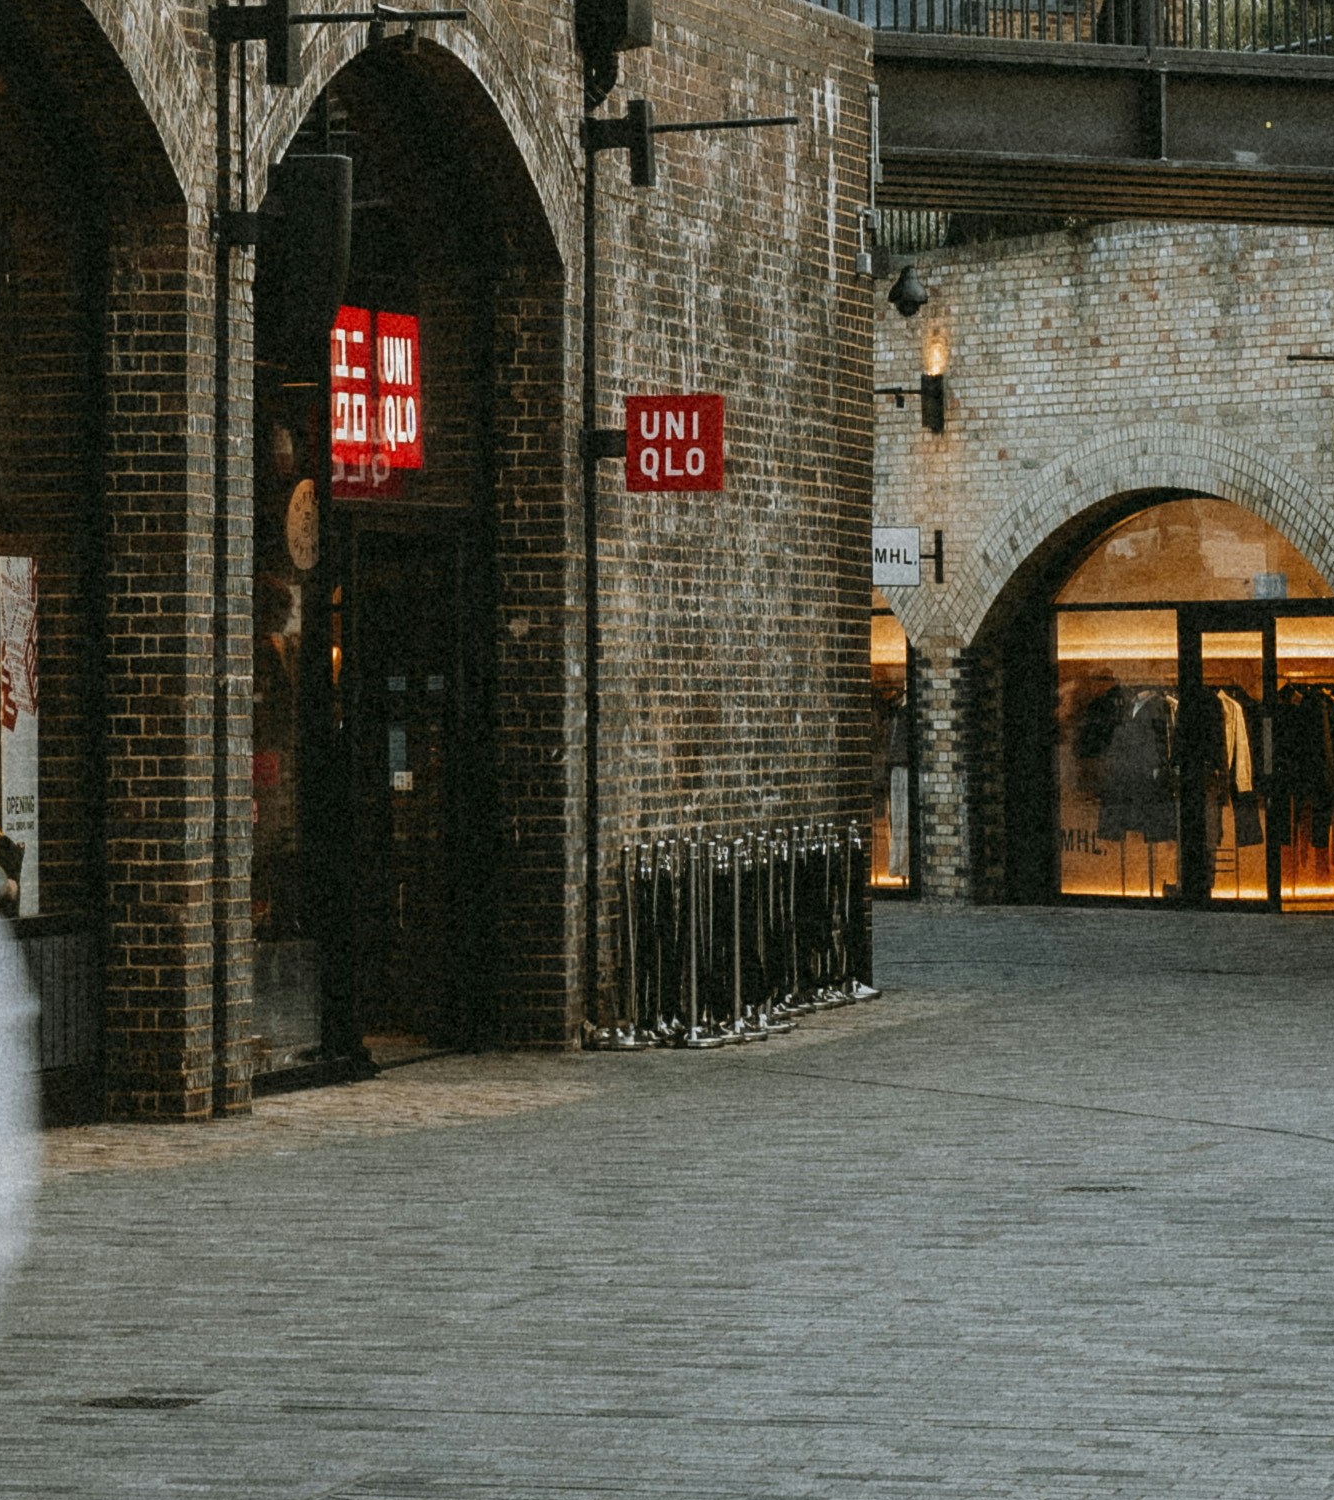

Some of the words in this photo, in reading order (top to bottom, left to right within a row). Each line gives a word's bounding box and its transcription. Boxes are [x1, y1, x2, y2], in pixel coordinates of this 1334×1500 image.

[383, 336, 412, 385] UNI
[385, 395, 417, 452] QLO
[641, 411, 699, 440] UNI
[640, 447, 705, 482] QLO
[7, 795, 34, 815] OPENING
